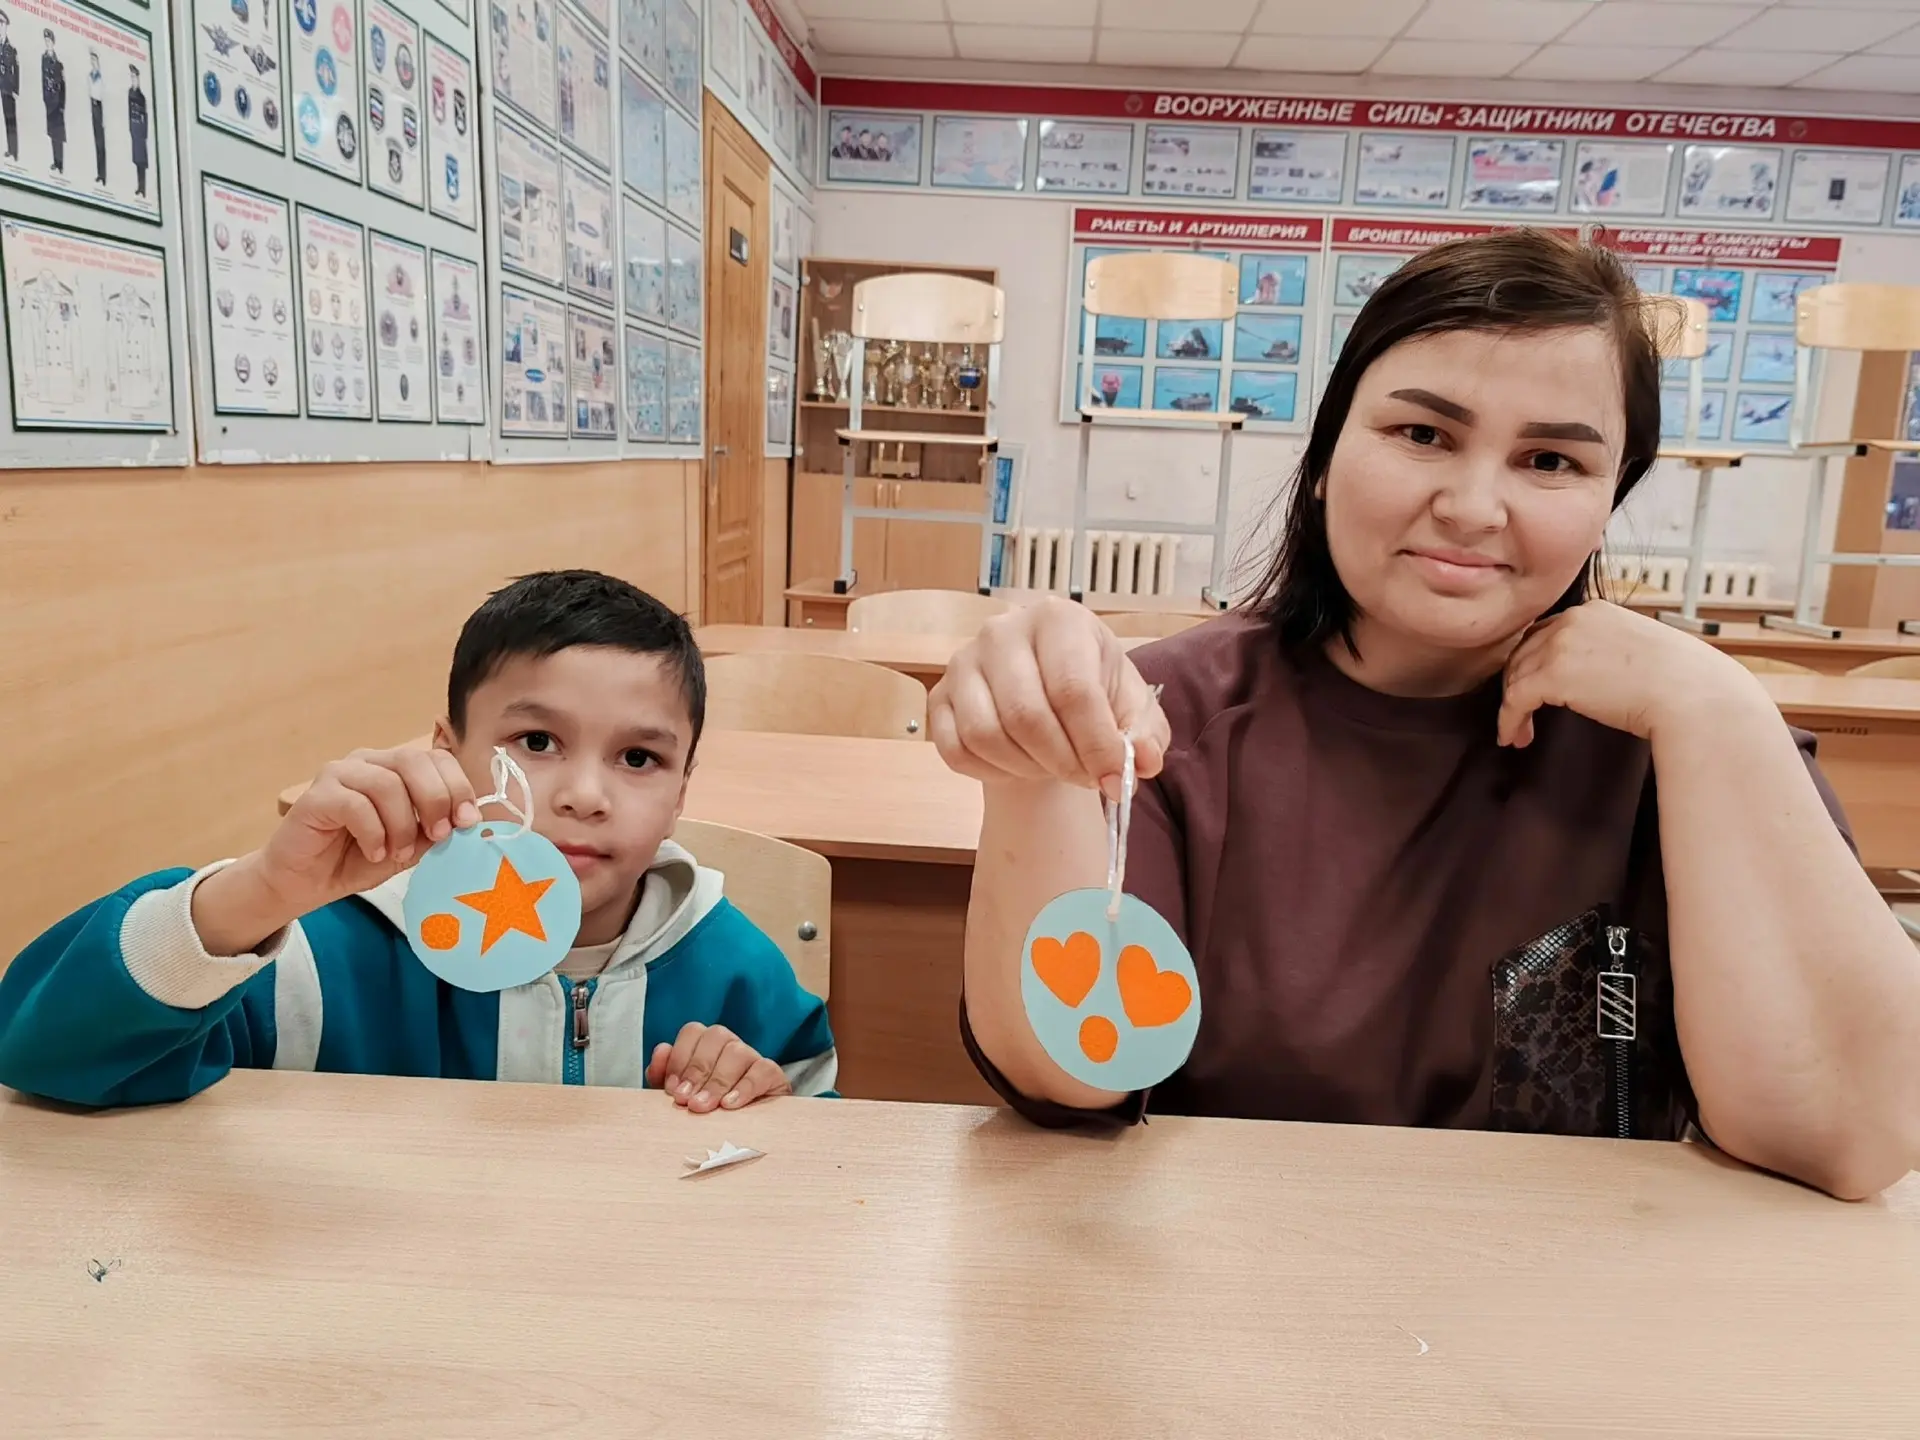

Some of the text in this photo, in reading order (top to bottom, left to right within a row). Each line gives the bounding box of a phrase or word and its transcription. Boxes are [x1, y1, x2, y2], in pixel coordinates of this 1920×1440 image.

[1153, 95, 1355, 122] ВООРУЖЕННЫЕ
[1625, 111, 1777, 138] ОТЕЧЕСТВА
[1090, 217, 1309, 239] РАКЕТЫ И АРТИЛЛЕРИЯ
[1617, 229, 1811, 249] БОЕВЫЕ САМОЛЕТЫ
[1647, 243, 1781, 259] И ВЕРТОЛЕТЫ
